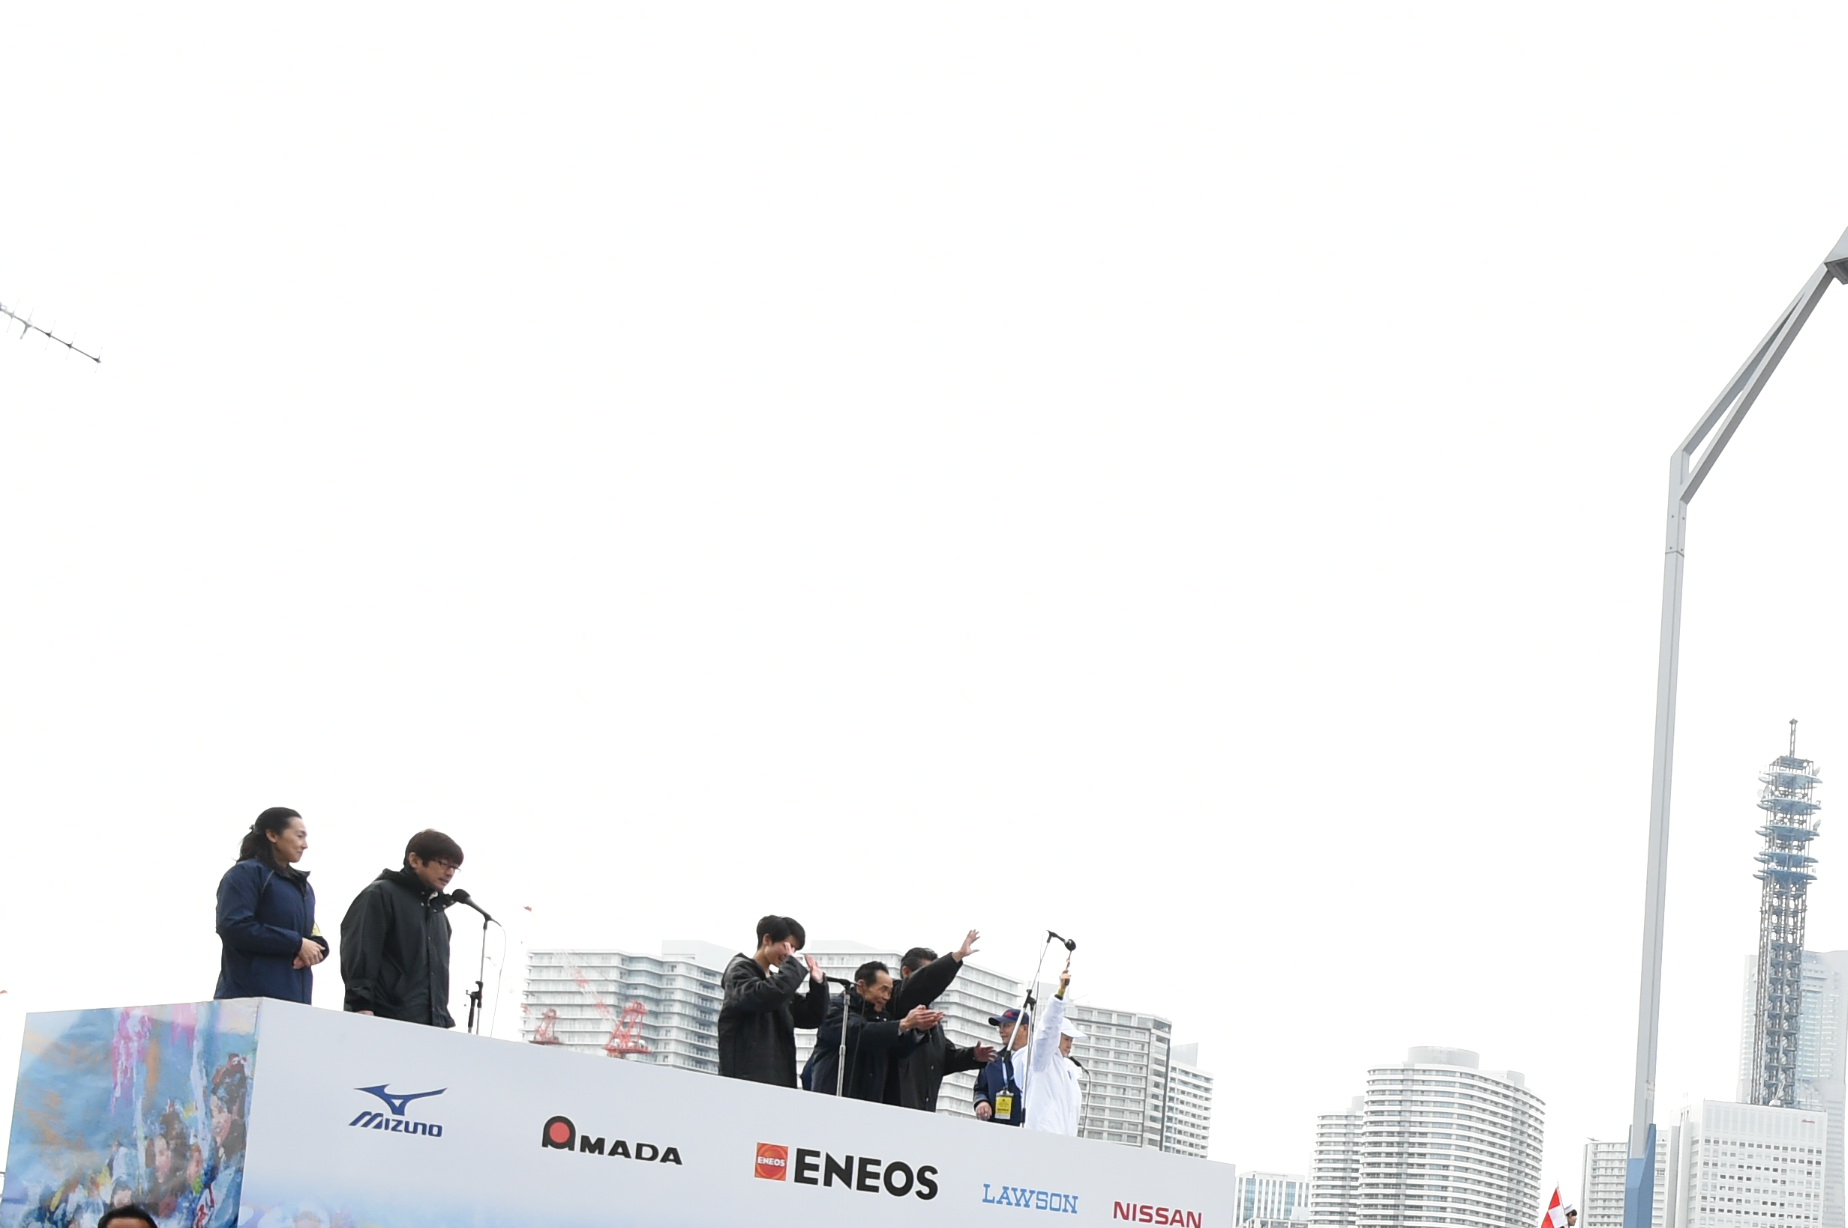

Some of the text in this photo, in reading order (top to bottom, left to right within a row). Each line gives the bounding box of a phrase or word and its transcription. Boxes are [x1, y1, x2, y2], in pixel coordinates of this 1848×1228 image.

[348, 1111, 443, 1139] MIZUNO
[541, 1115, 684, 1166] AMADA
[757, 1155, 786, 1168] ENEOS
[793, 1147, 939, 1201] ENEOS
[982, 1183, 1079, 1215] LAWSON
